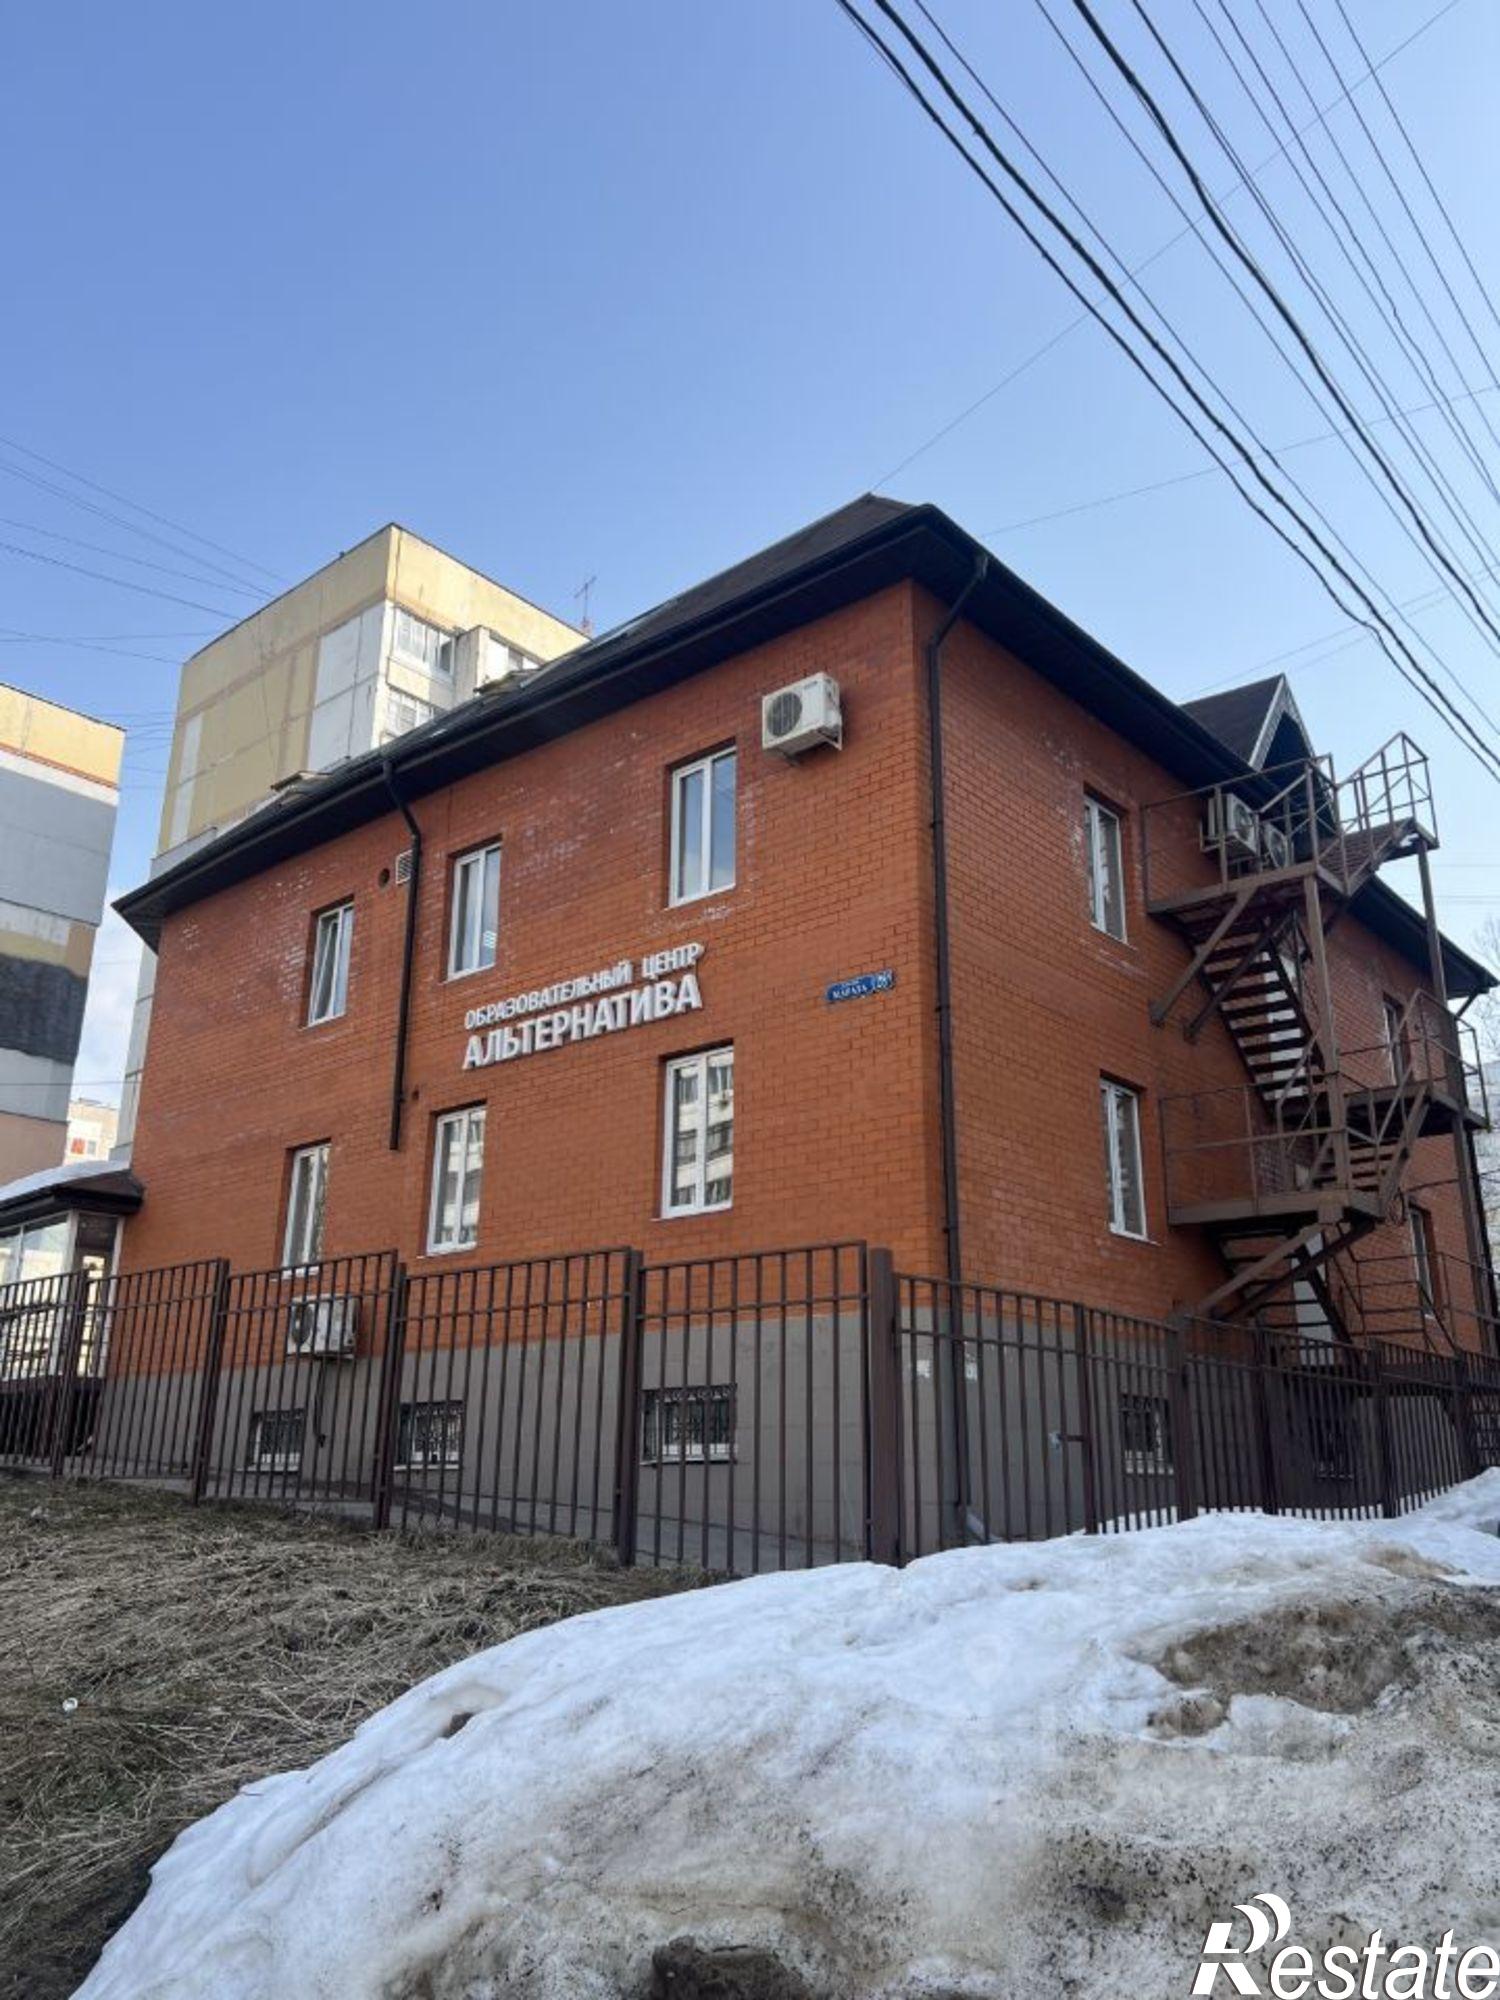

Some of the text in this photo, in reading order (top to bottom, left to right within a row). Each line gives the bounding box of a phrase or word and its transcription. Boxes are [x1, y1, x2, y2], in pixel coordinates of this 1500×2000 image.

[461, 973, 703, 1070] АЛЬТЕРНАТИВА
[464, 942, 704, 1030] ОБРАЗОВАТЕЛЬНЫЙ ЦЕНТР
